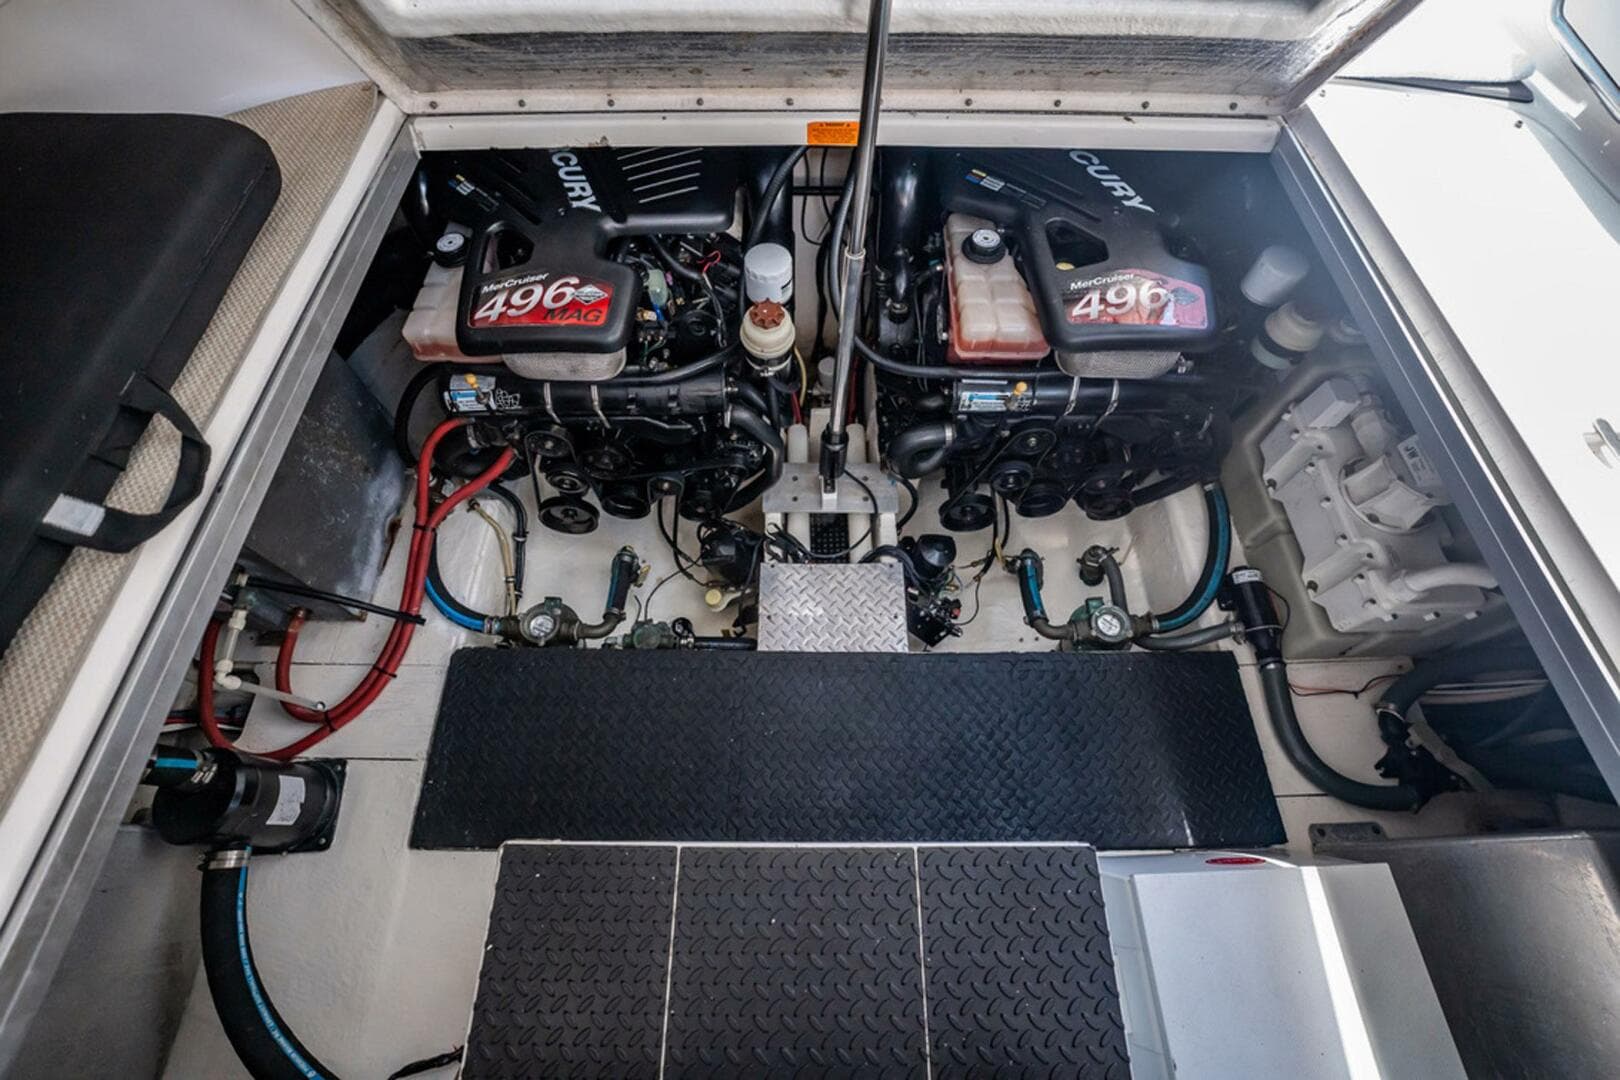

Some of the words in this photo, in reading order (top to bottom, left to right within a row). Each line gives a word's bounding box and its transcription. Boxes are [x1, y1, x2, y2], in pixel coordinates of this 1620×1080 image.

[481, 272, 550, 294] MerCruiser
[1070, 273, 1135, 291] MerCruiser
[474, 276, 580, 322] 496
[1071, 280, 1168, 320] 496
[543, 307, 602, 323] MAG
